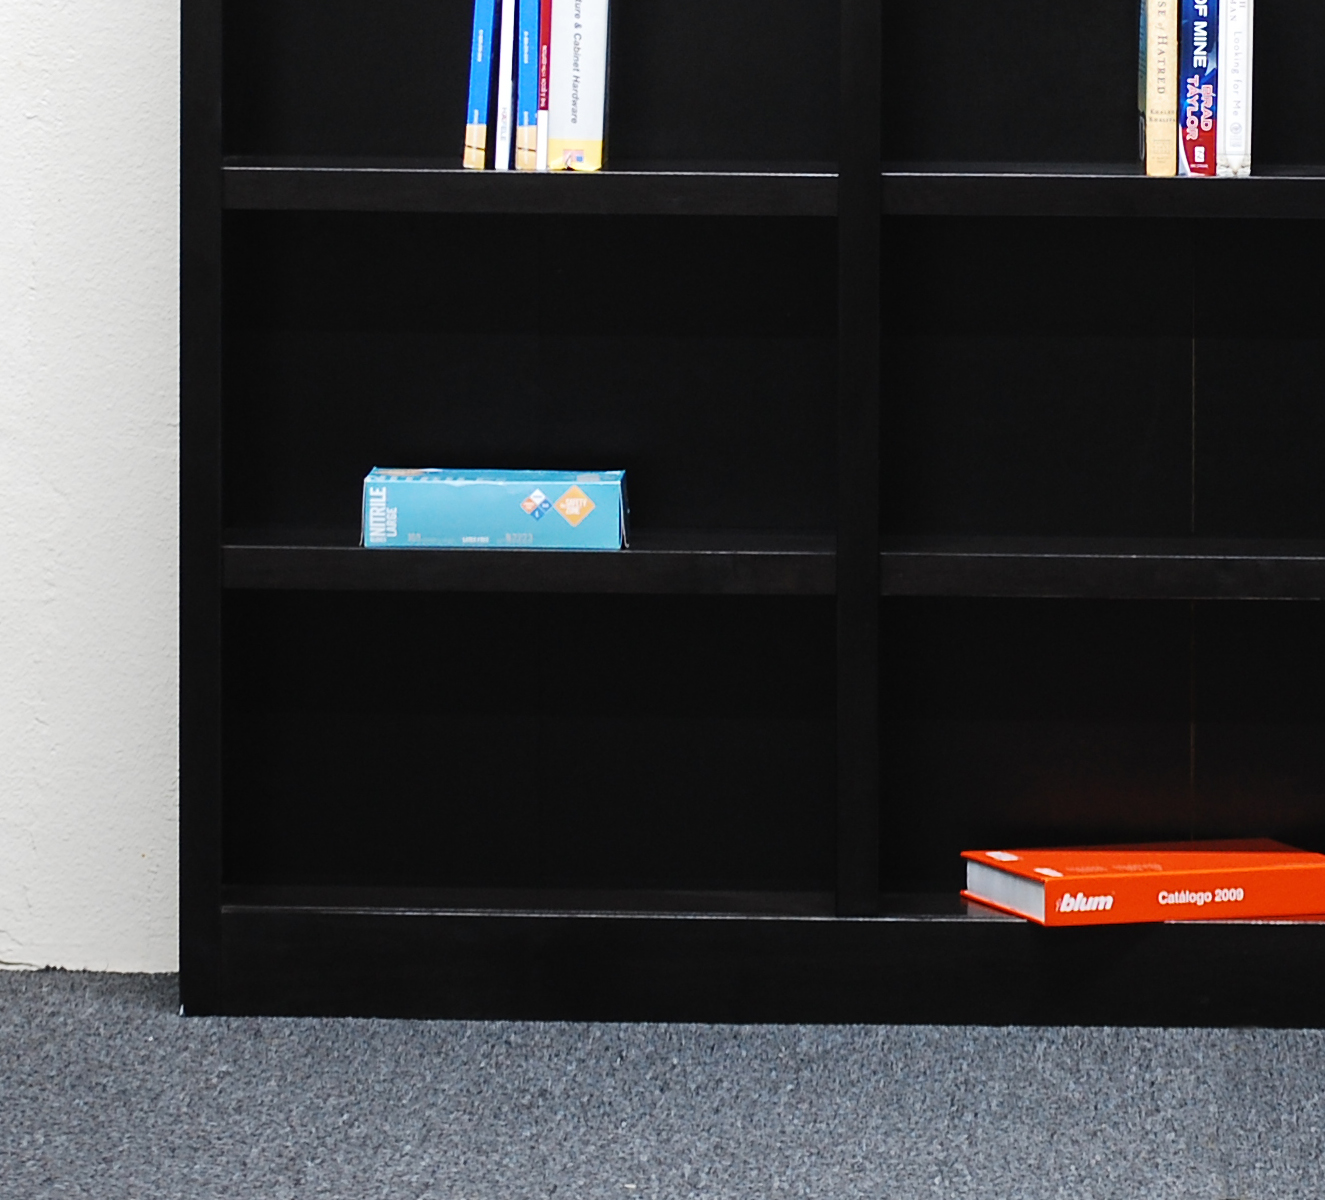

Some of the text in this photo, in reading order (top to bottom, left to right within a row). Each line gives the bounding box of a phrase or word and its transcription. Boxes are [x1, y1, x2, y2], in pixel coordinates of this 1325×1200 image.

[573, 33, 582, 72] Cabinet
[1157, 35, 1168, 94] HATRED
[1193, 21, 1208, 68] MINE
[1231, 31, 1242, 116] Looking for Me
[571, 75, 582, 124] Hardware
[1186, 74, 1199, 140] TAYLOR
[1200, 84, 1215, 131] BRAD
[369, 486, 387, 537] NITRILE
[386, 507, 398, 538] LARGE
[1059, 892, 1114, 912] blum
[1158, 888, 1244, 905] Catálogo 2009
